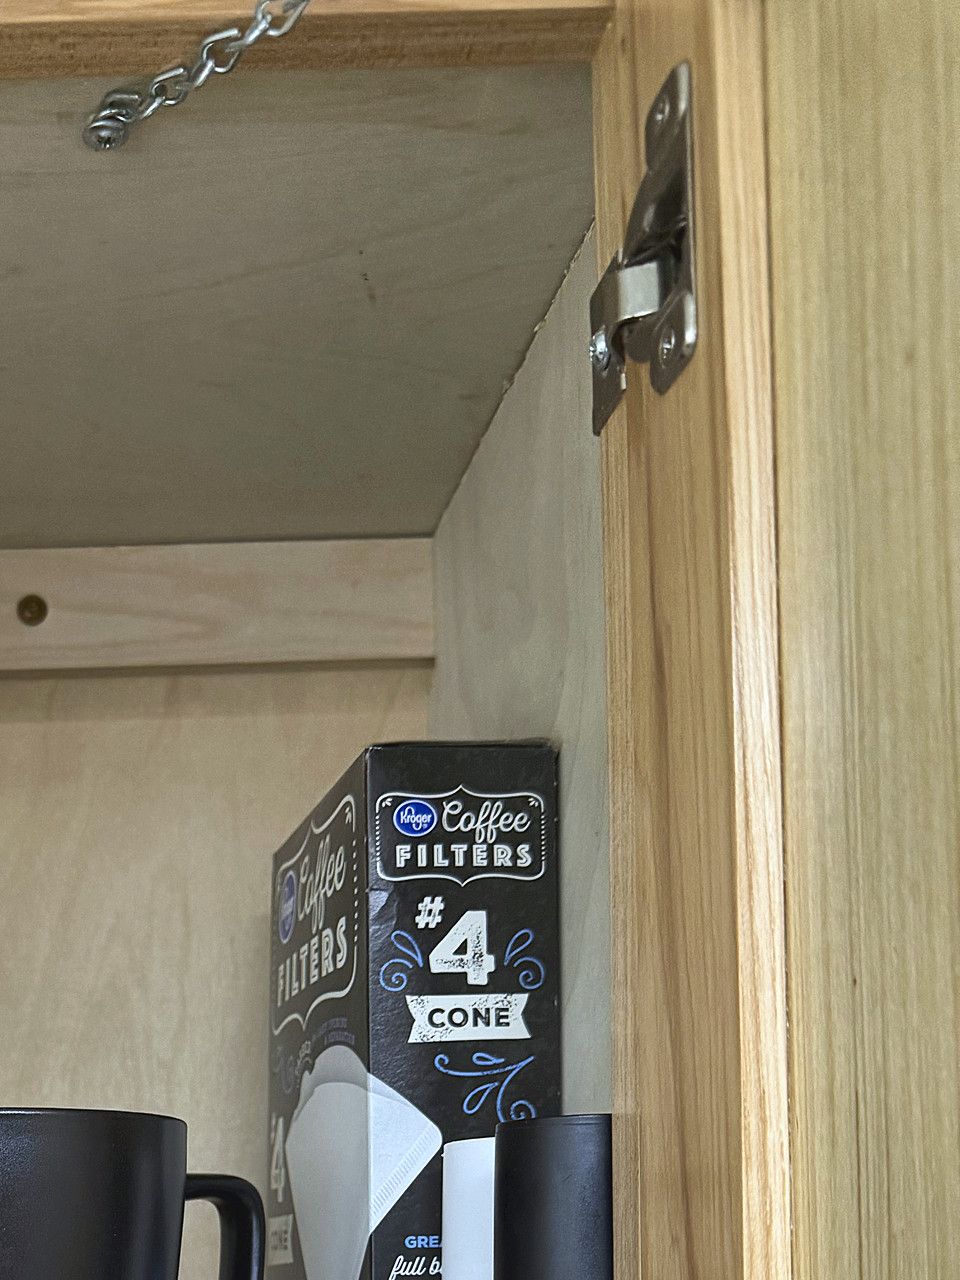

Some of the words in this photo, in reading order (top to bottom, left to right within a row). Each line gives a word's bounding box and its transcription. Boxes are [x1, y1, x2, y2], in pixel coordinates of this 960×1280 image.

[400, 806, 431, 830] Kroger
[442, 801, 531, 843] Coffee
[395, 844, 532, 868] FILTERS
[297, 833, 346, 934] Coffee
[277, 916, 346, 1007] FILTERS
[427, 1006, 511, 1028] CONE
[404, 1235, 442, 1248] GRE
[429, 1256, 442, 1275] b
